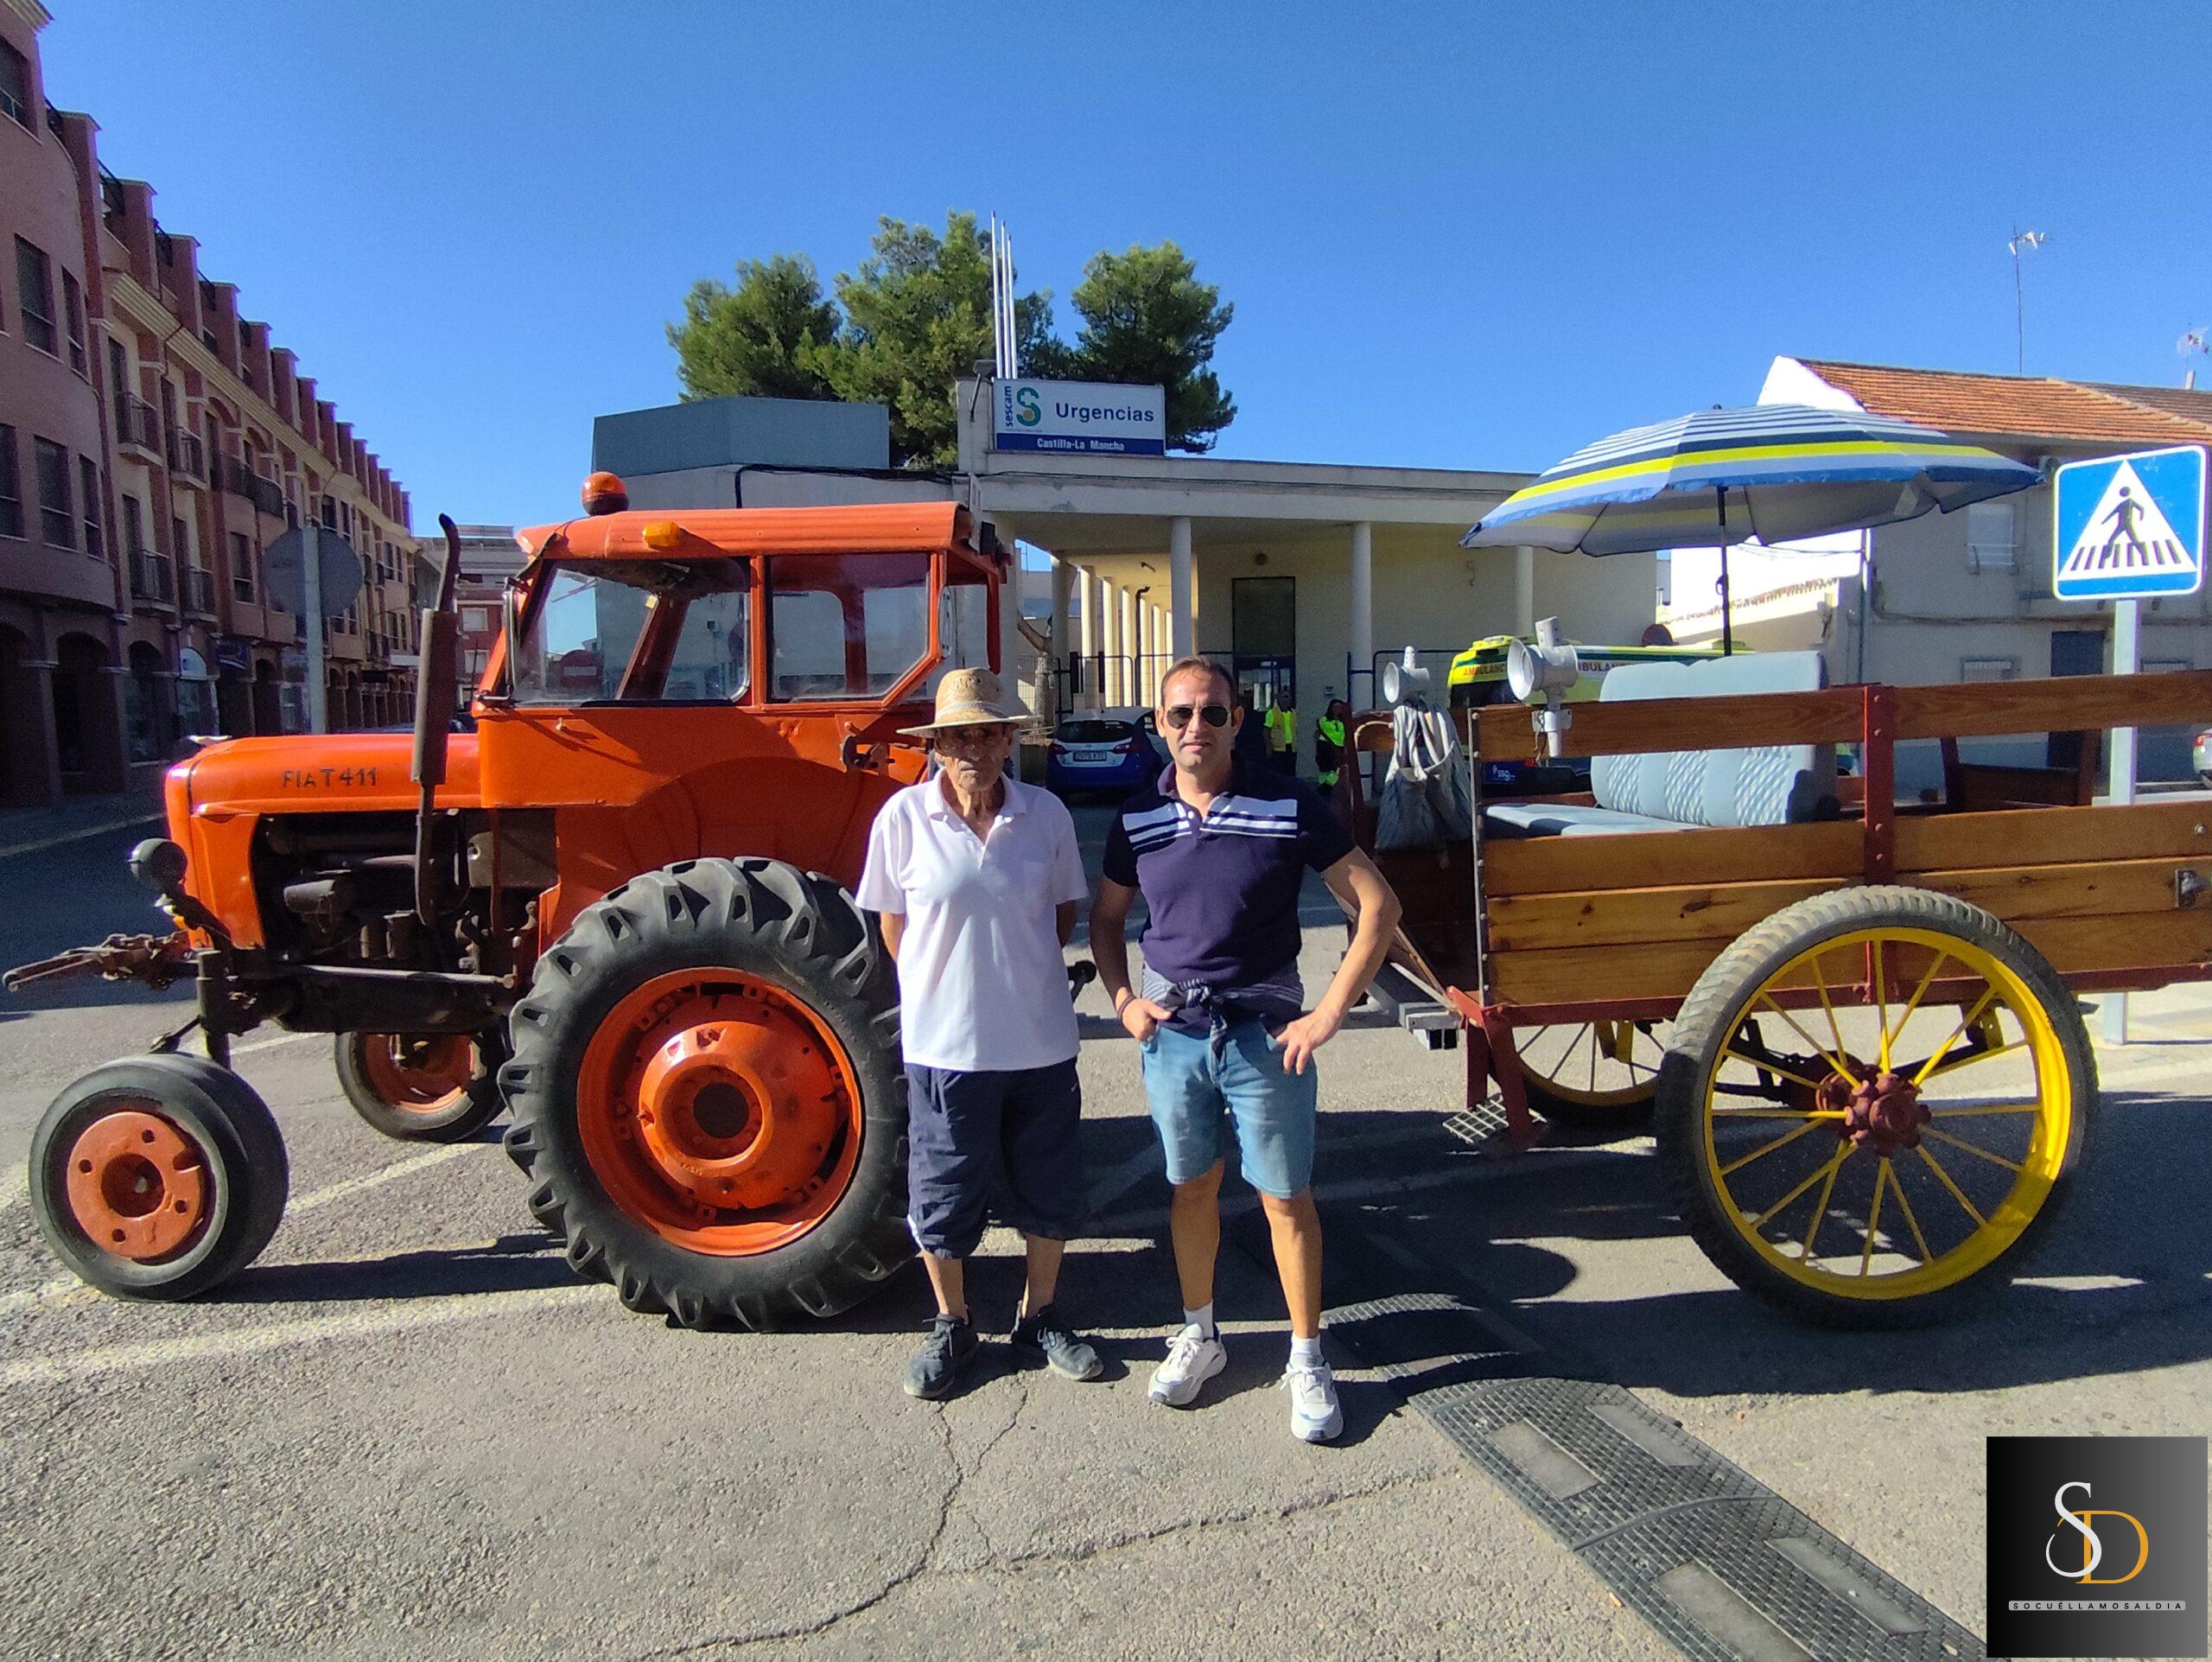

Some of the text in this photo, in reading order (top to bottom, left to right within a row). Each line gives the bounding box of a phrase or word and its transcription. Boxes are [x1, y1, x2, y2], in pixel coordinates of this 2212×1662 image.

[1004, 385, 1013, 428] sescam
[1055, 402, 1155, 423] Urgencias
[1037, 437, 1125, 451] Castilla-La Mancha
[283, 767, 378, 788] FIAT 411
